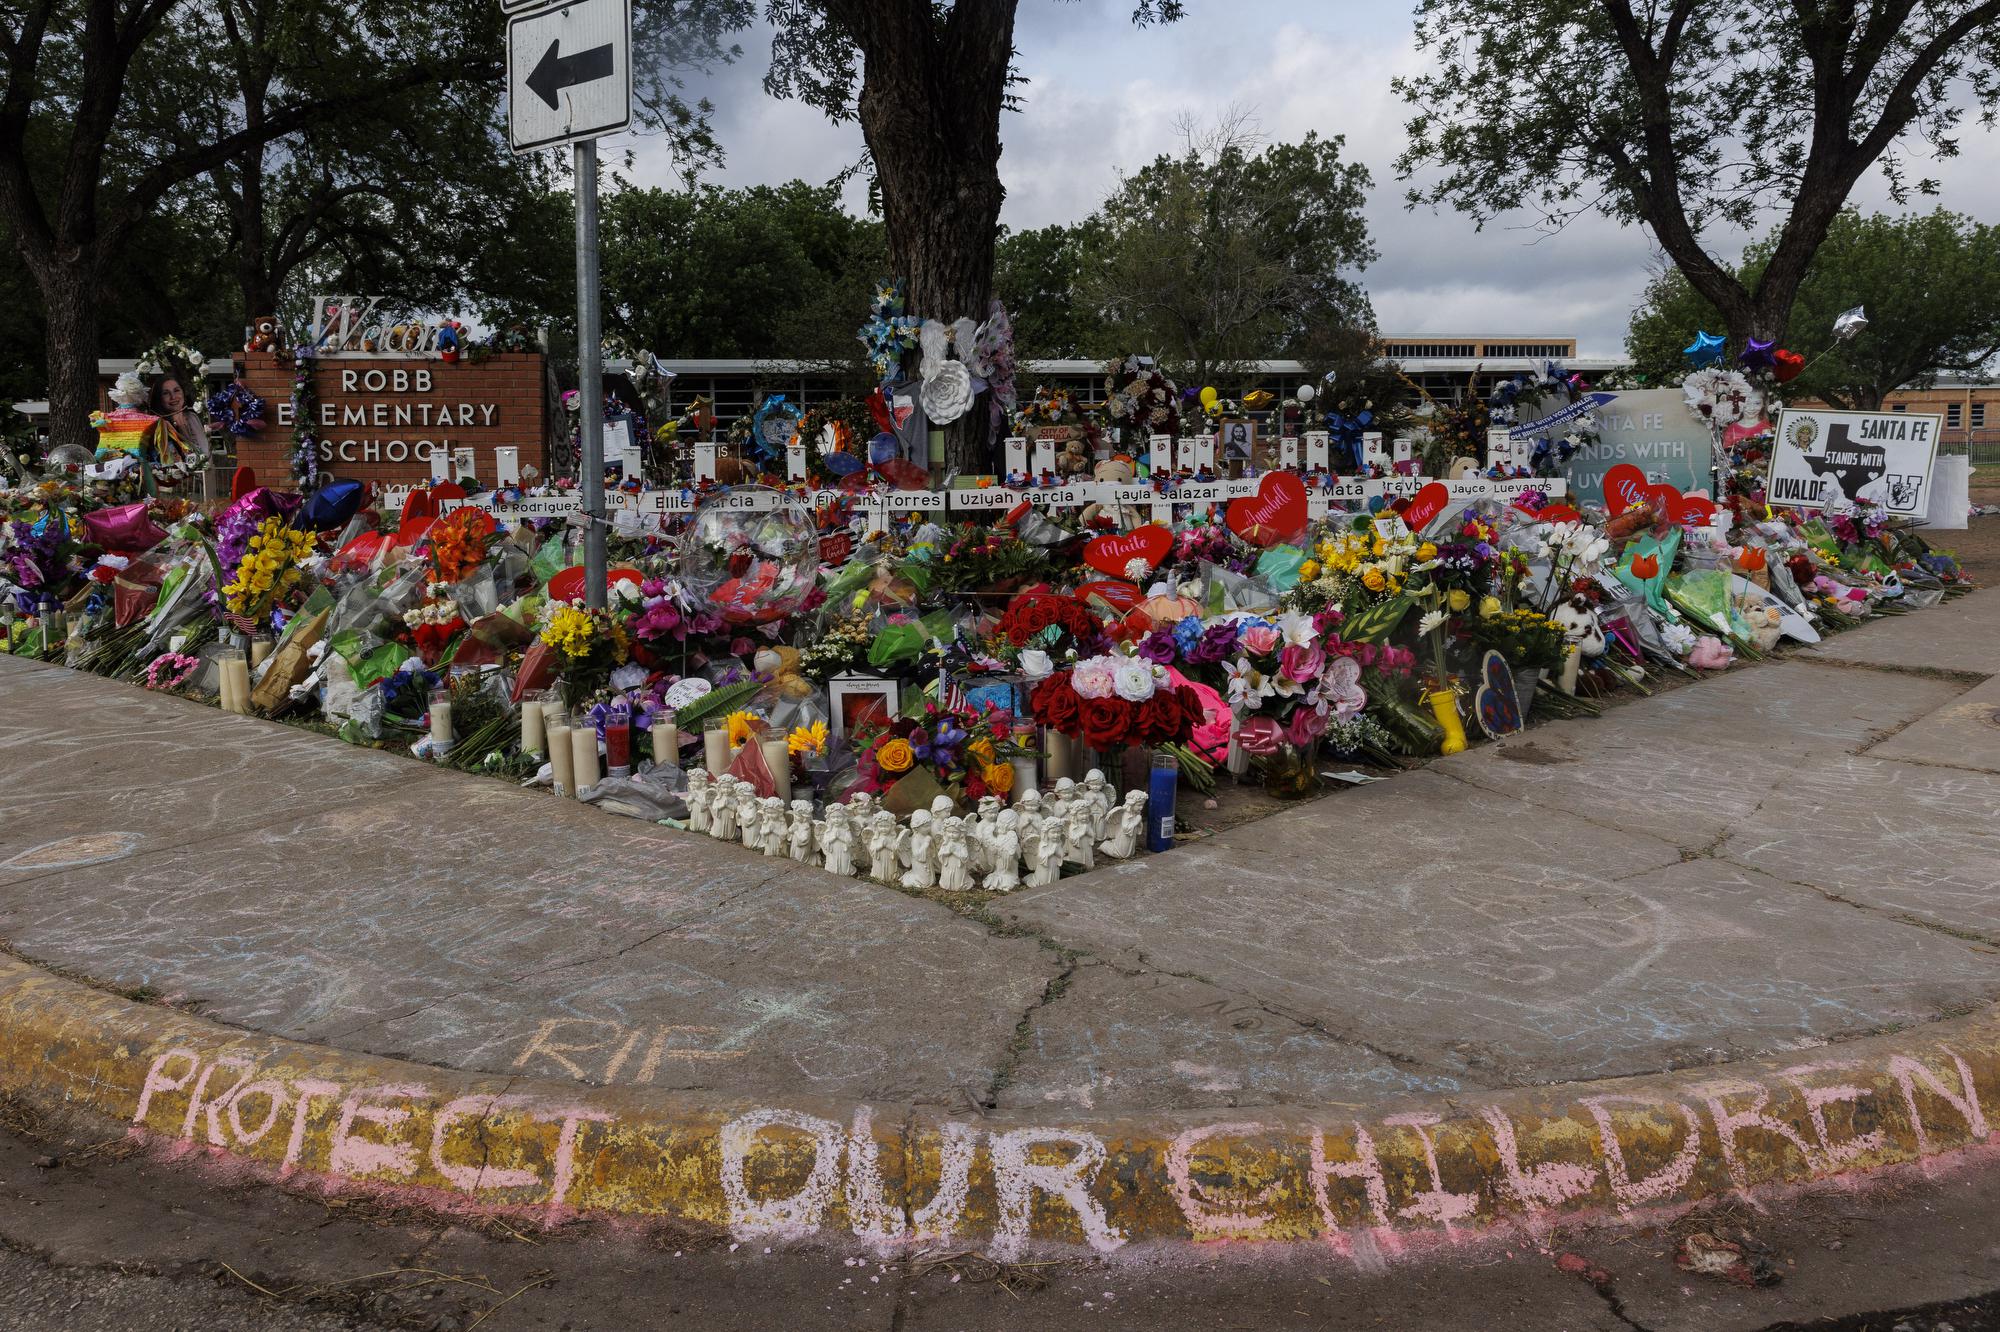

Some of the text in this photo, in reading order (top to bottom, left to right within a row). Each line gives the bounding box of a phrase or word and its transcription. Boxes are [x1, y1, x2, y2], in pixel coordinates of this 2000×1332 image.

[341, 368, 433, 393] ROBB
[277, 403, 496, 427] EEMENTARY
[1553, 408, 1568, 418] YOU
[1567, 395, 1594, 411] UVALDE
[1642, 413, 1665, 430] FE
[1859, 418, 1930, 442] SANTA FE
[1041, 427, 1057, 435] CITY
[718, 445, 729, 458] IS
[1633, 440, 1686, 458] WITH
[1824, 450, 1884, 468] STANDS WITH
[1114, 490, 1151, 502] Layla
[1160, 488, 1219, 500] Salazar
[1322, 483, 1364, 497] Mata
[1452, 482, 1552, 495] Jayce Luevanos
[1774, 477, 1828, 502] UVALDE
[656, 497, 689, 509] Ellie
[885, 495, 941, 507] Torres
[960, 492, 1014, 507] Uziyah
[1021, 490, 1074, 503] Garcia
[512, 501, 580, 514] Rodriguez
[130, 1044, 1987, 1262] PROTECT OUR CHILDREN
